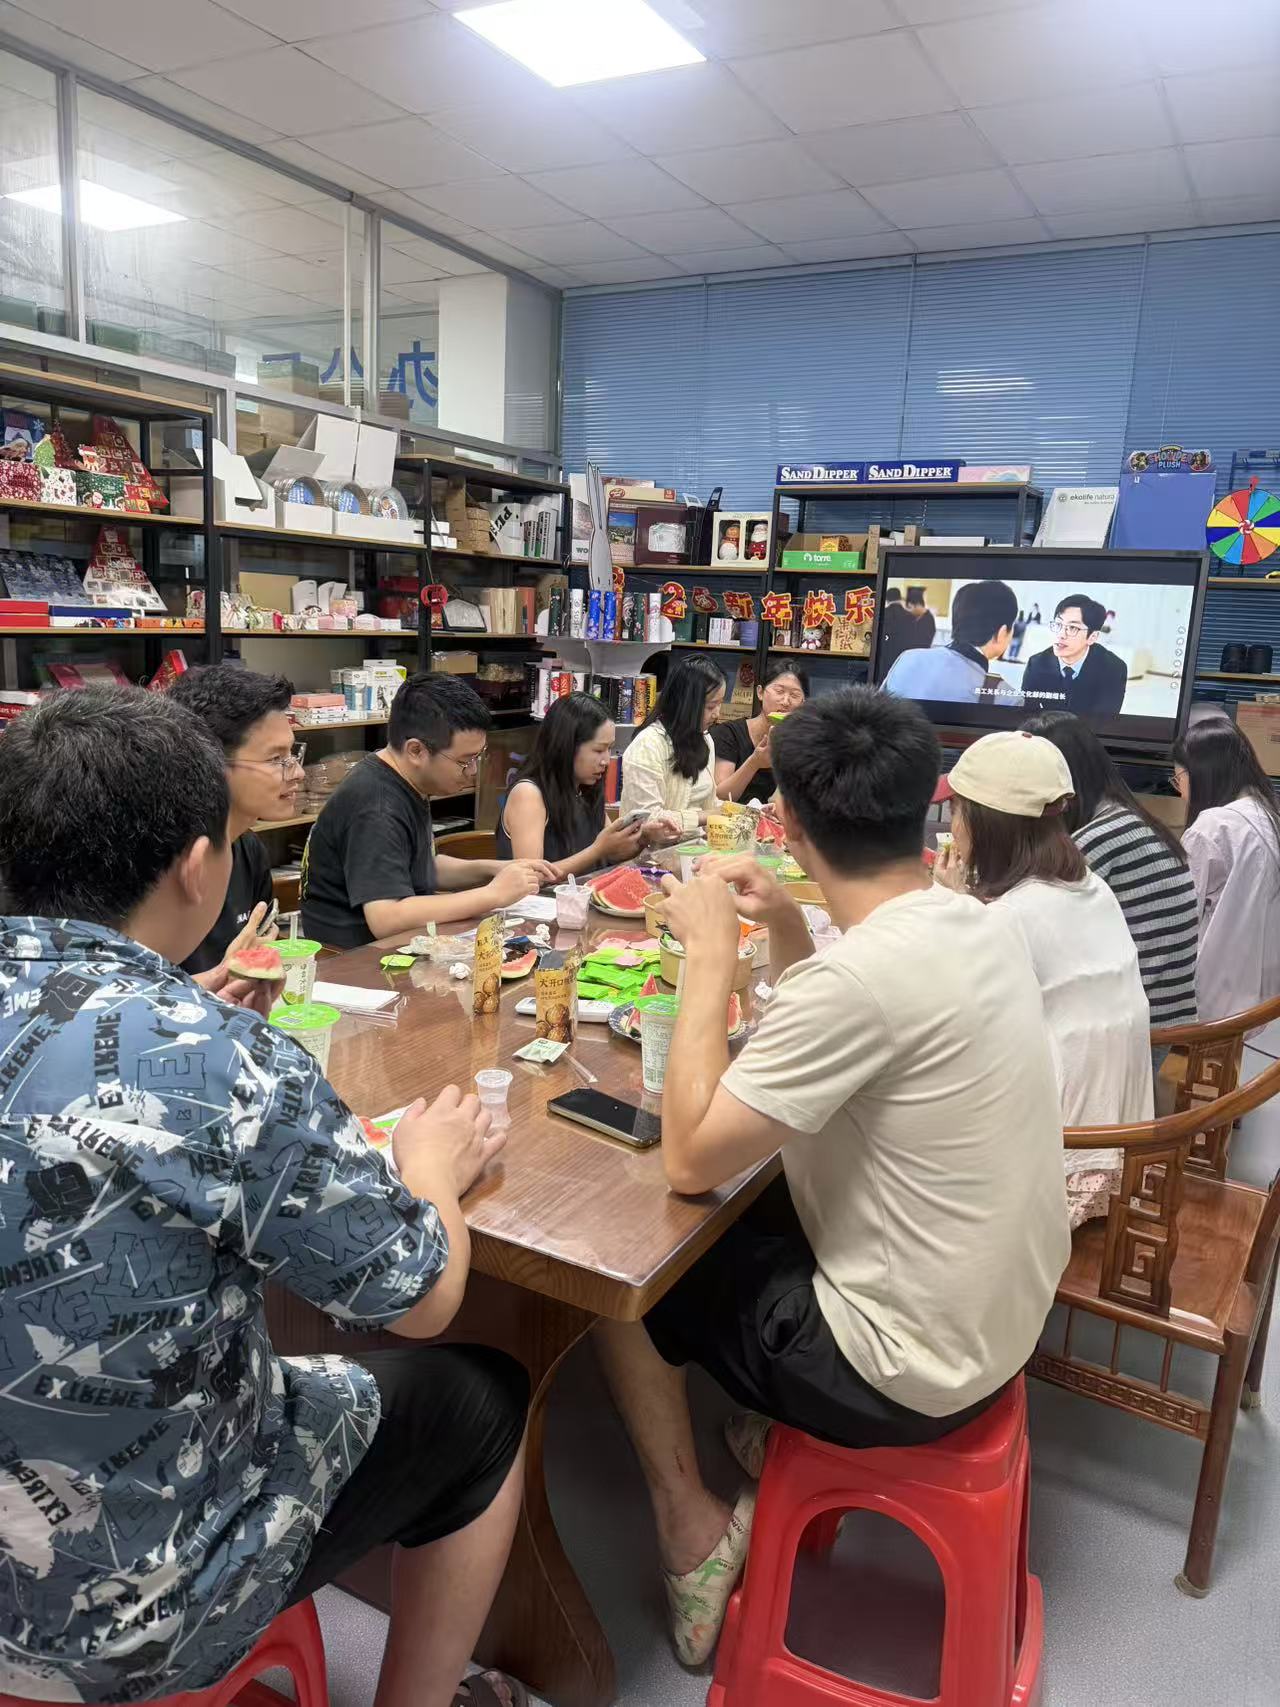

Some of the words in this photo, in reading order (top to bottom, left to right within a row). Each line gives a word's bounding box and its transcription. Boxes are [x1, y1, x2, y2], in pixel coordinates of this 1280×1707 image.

[868, 465, 900, 479] SAND
[902, 464, 953, 478] DIPPER
[1158, 461, 1181, 469] PLUSH
[781, 467, 811, 480] SAND
[813, 466, 858, 480] DIPPER
